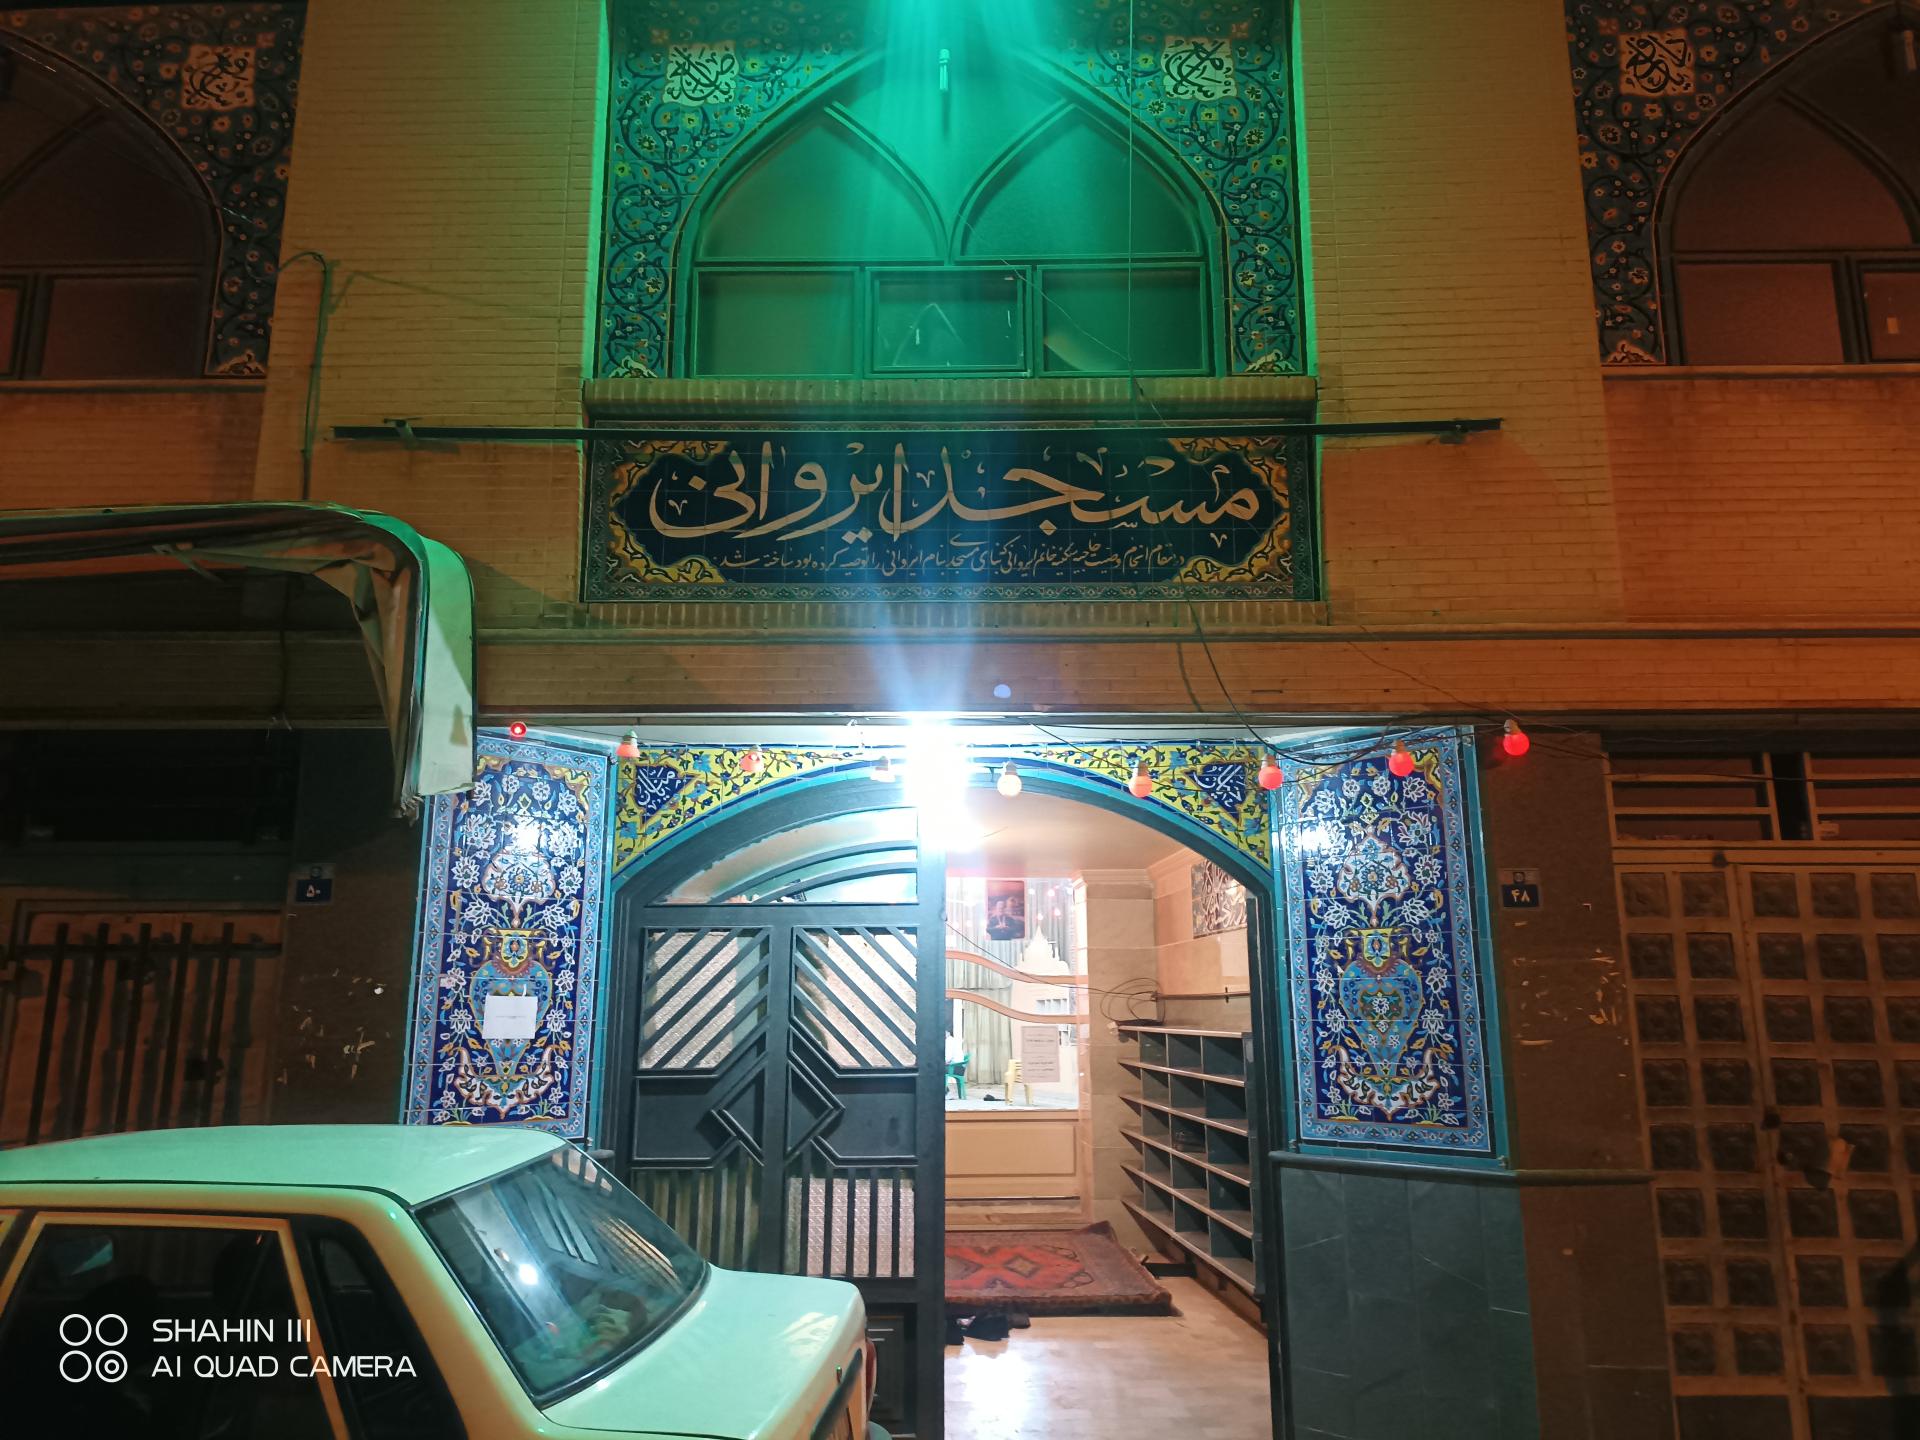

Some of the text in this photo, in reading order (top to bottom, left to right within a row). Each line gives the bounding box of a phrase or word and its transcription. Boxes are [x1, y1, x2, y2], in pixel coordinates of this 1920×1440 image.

[649, 440, 1260, 544] مسجد ایروانی
[881, 545, 923, 577] ایروانی
[1000, 545, 1038, 577] ایروانی
